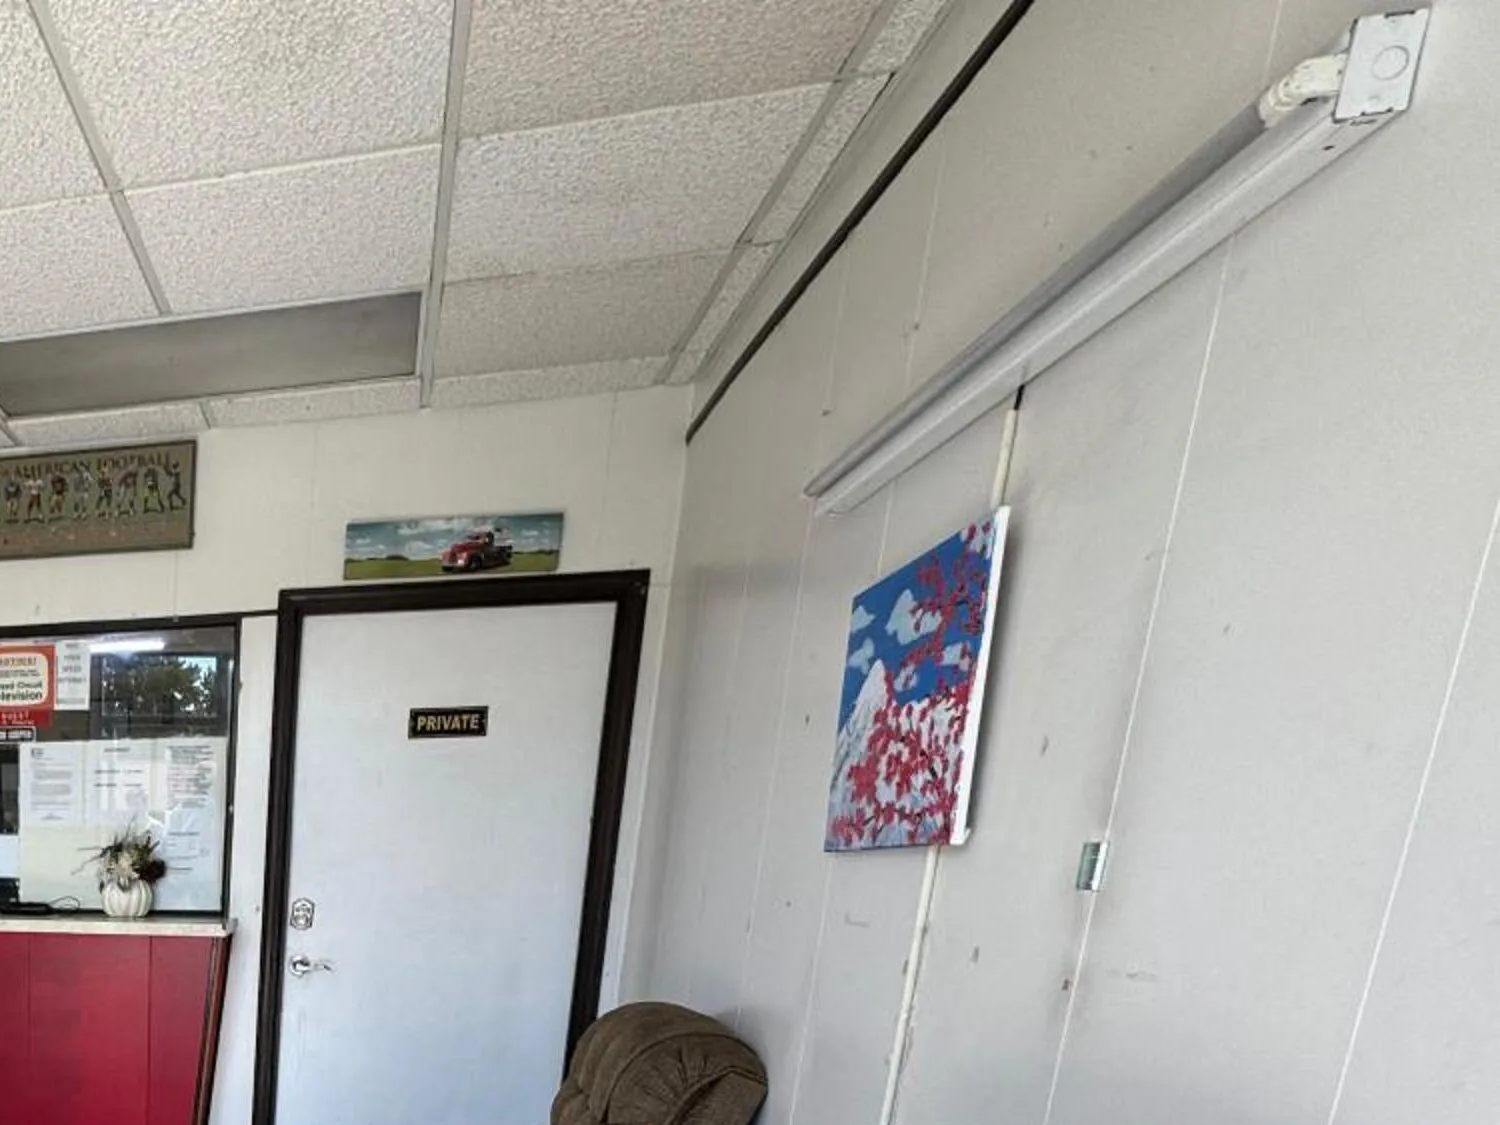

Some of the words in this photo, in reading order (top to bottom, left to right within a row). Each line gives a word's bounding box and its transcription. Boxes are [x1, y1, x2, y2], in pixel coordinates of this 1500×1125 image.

[14, 459, 92, 479] AMERICAN
[97, 452, 171, 471] FOOTBALL
[417, 713, 480, 731] PRIVATE
